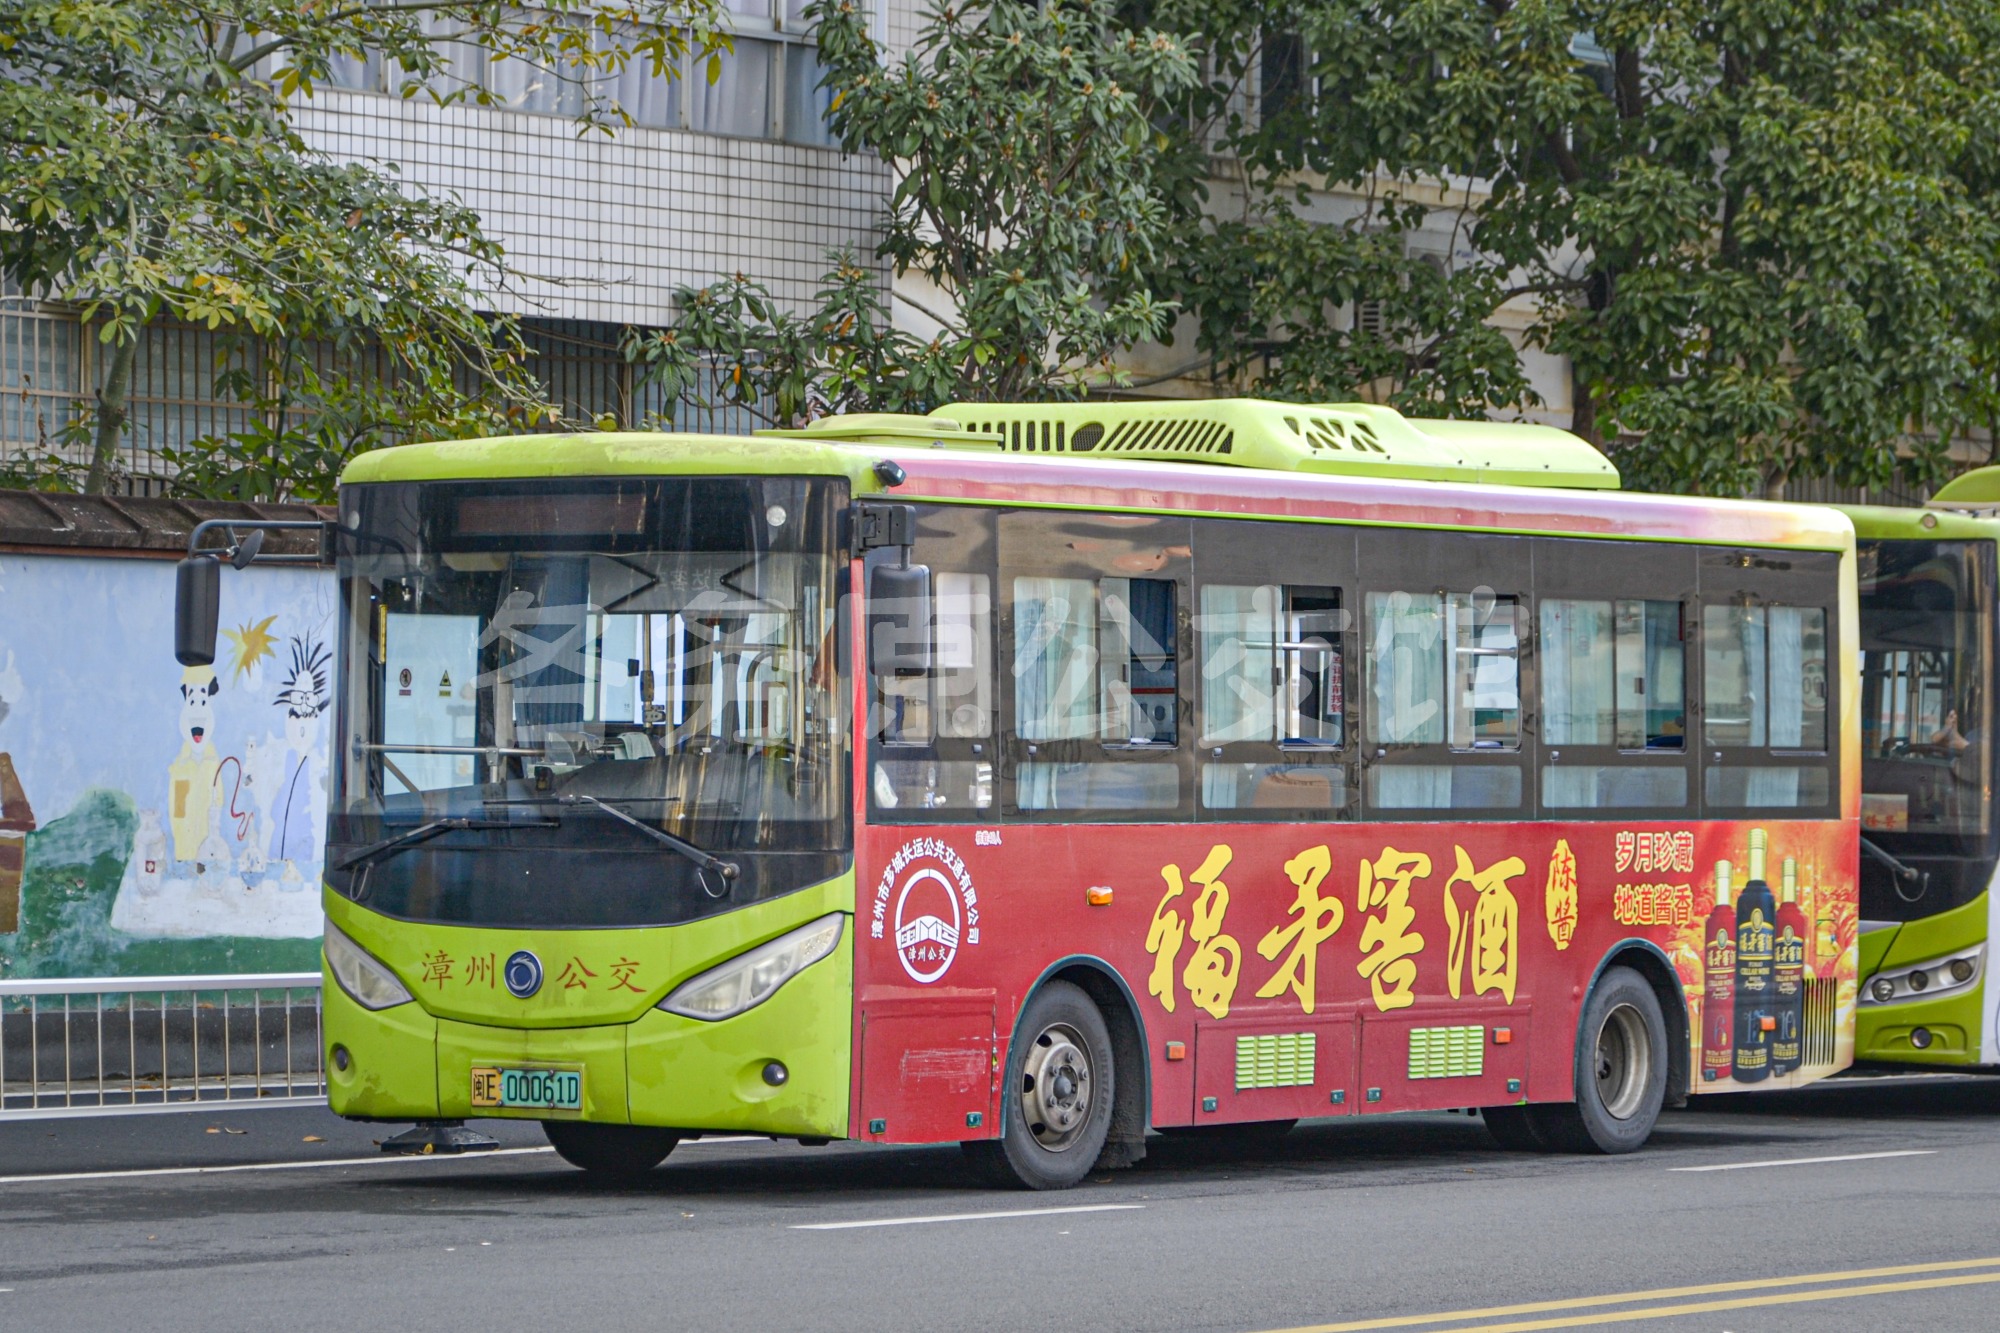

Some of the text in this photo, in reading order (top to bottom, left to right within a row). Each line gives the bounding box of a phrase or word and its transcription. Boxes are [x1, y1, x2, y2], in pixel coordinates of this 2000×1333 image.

[1615, 831, 1694, 873] 岁月珍藏
[871, 836, 980, 945] 漳州市芗城长运公共交通有限公司
[1549, 852, 1577, 943] 陈酱
[1613, 884, 1693, 926] 地道酱香
[908, 945, 947, 963] 漳州公交
[1145, 843, 1527, 1019] 福矛窖酒
